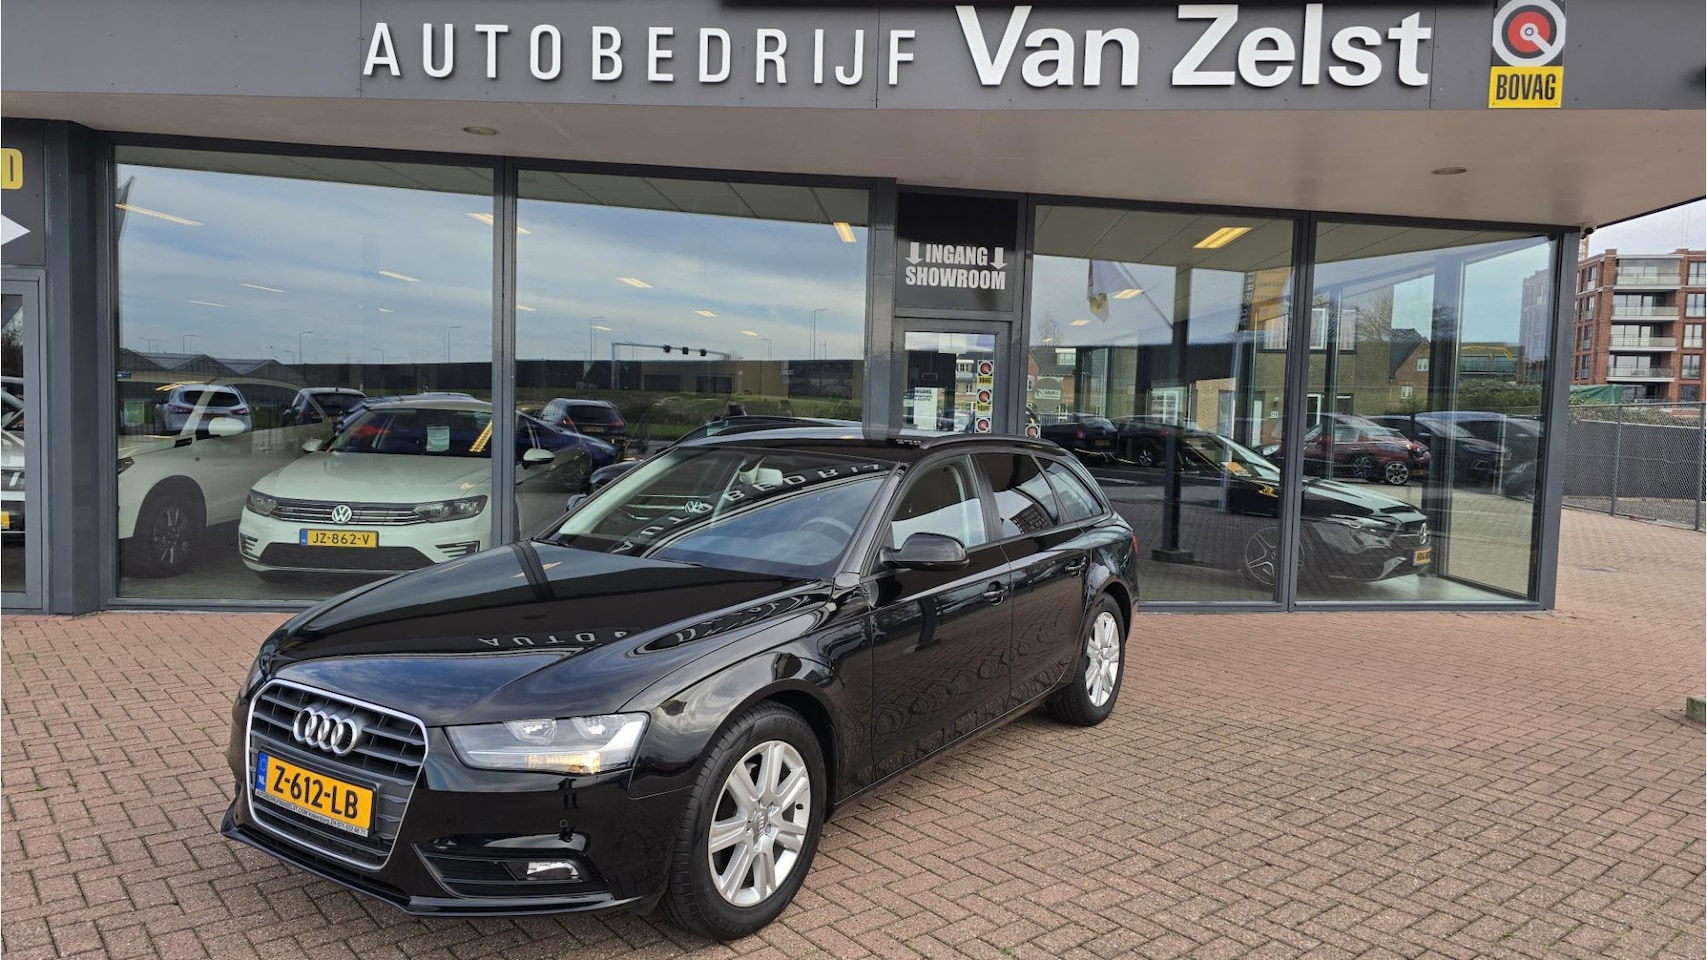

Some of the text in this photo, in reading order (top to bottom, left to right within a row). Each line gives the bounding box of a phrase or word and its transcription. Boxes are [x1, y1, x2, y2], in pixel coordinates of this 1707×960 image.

[363, 3, 1432, 87] AUTOBEDRIJF Van Zelst
[1496, 73, 1556, 100] BOVAG
[925, 243, 989, 266] INGANG
[905, 265, 1006, 290] SHOWROOM
[312, 532, 370, 545] JZ-862-V
[273, 765, 359, 819] Z-612-LB
